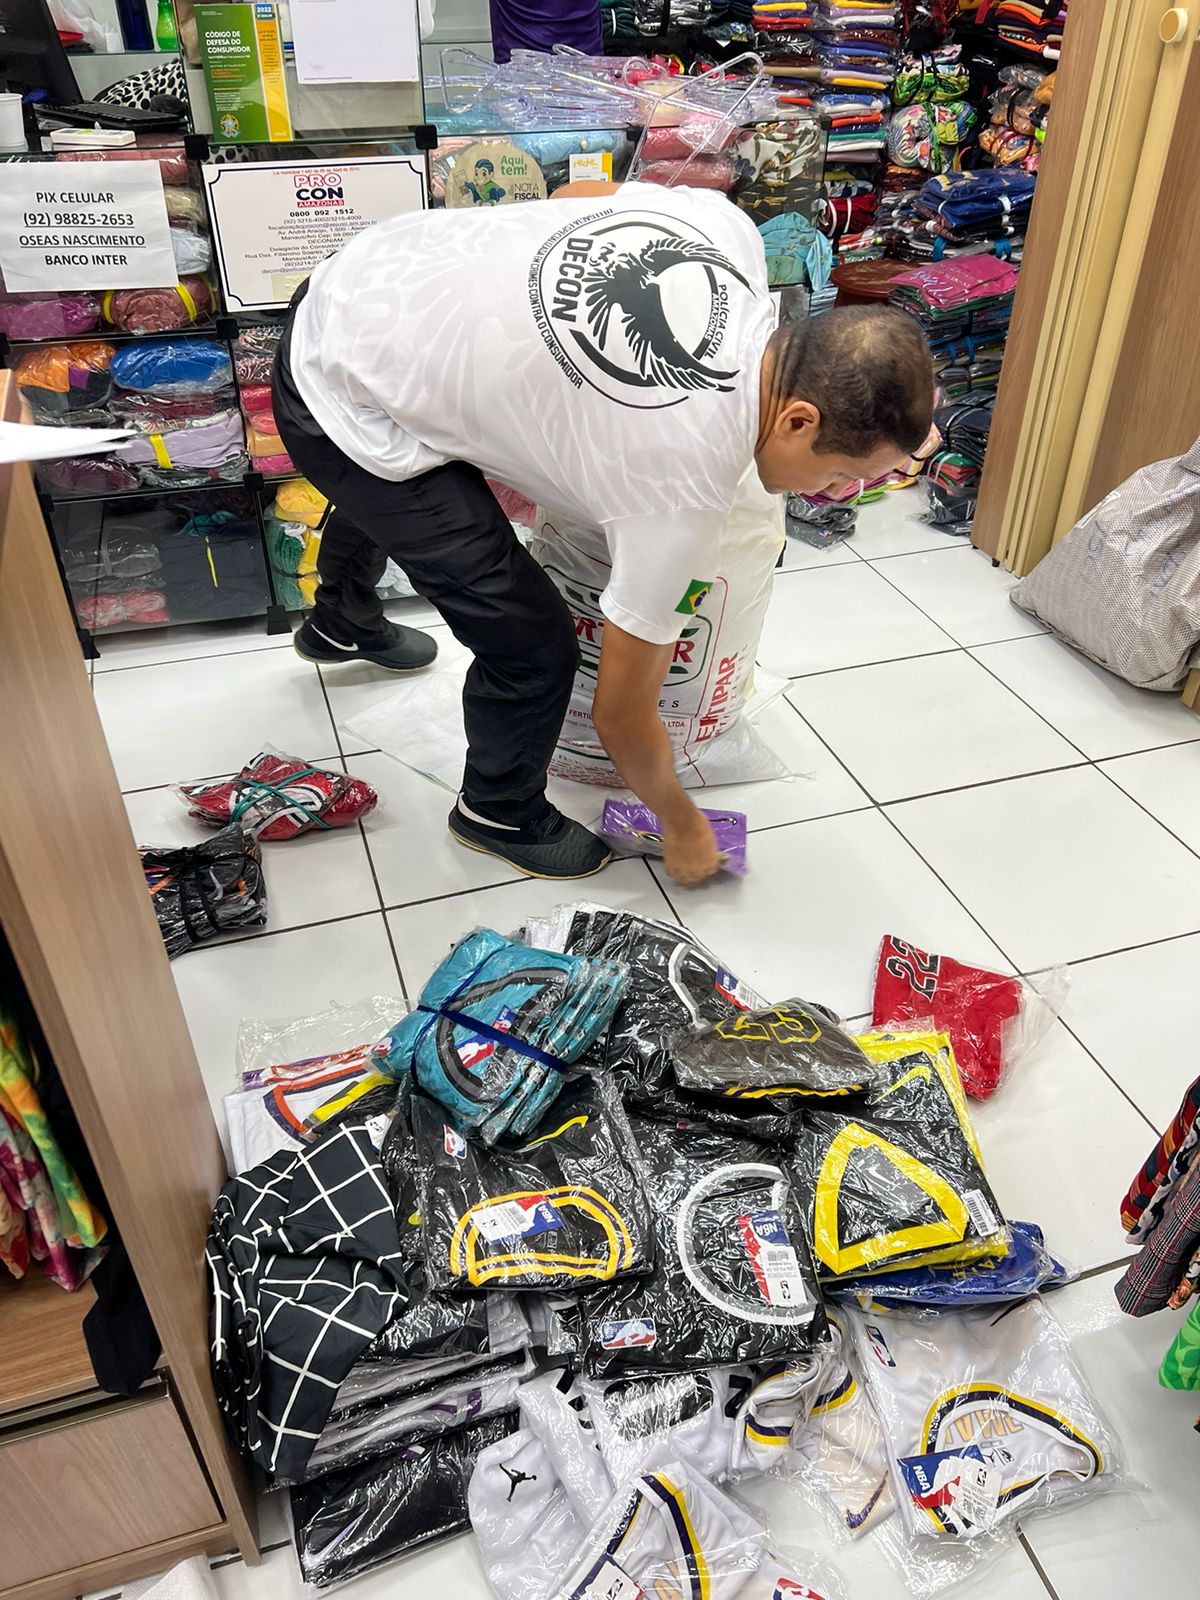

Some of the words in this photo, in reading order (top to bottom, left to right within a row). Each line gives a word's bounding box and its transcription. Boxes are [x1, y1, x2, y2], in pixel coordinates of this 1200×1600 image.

[205, 30, 231, 38] CÓDIGO
[207, 46, 251, 54] CONSUMIDOR
[500, 155, 524, 168] Aqui
[501, 164, 528, 176] tem!
[293, 172, 342, 188] PRO
[296, 186, 344, 200] CON
[513, 183, 540, 192] NOTA
[36, 192, 57, 203] PIX
[60, 192, 115, 204] CELULAR
[514, 192, 541, 200] FISCAL
[23, 212, 51, 227] (92)
[54, 212, 134, 226] 98825-2653
[19, 235, 60, 246] OSEAS
[62, 235, 145, 246] NASCIMENTO
[45, 255, 89, 266] BANCO
[92, 254, 128, 266] INTER
[528, 263, 540, 288] CRIMES
[551, 237, 594, 323] DECON
[528, 289, 544, 323] CONTRA
[718, 284, 730, 330] POLÍCIA
[703, 293, 720, 341] AMAZONAS
[537, 321, 547, 330] O
[704, 331, 724, 359] CIVIL
[540, 329, 584, 390] CONSUMIDOR
[537, 1204, 556, 1224] NBA
[755, 1222, 778, 1236] NBA
[912, 1465, 932, 1491] NBA
